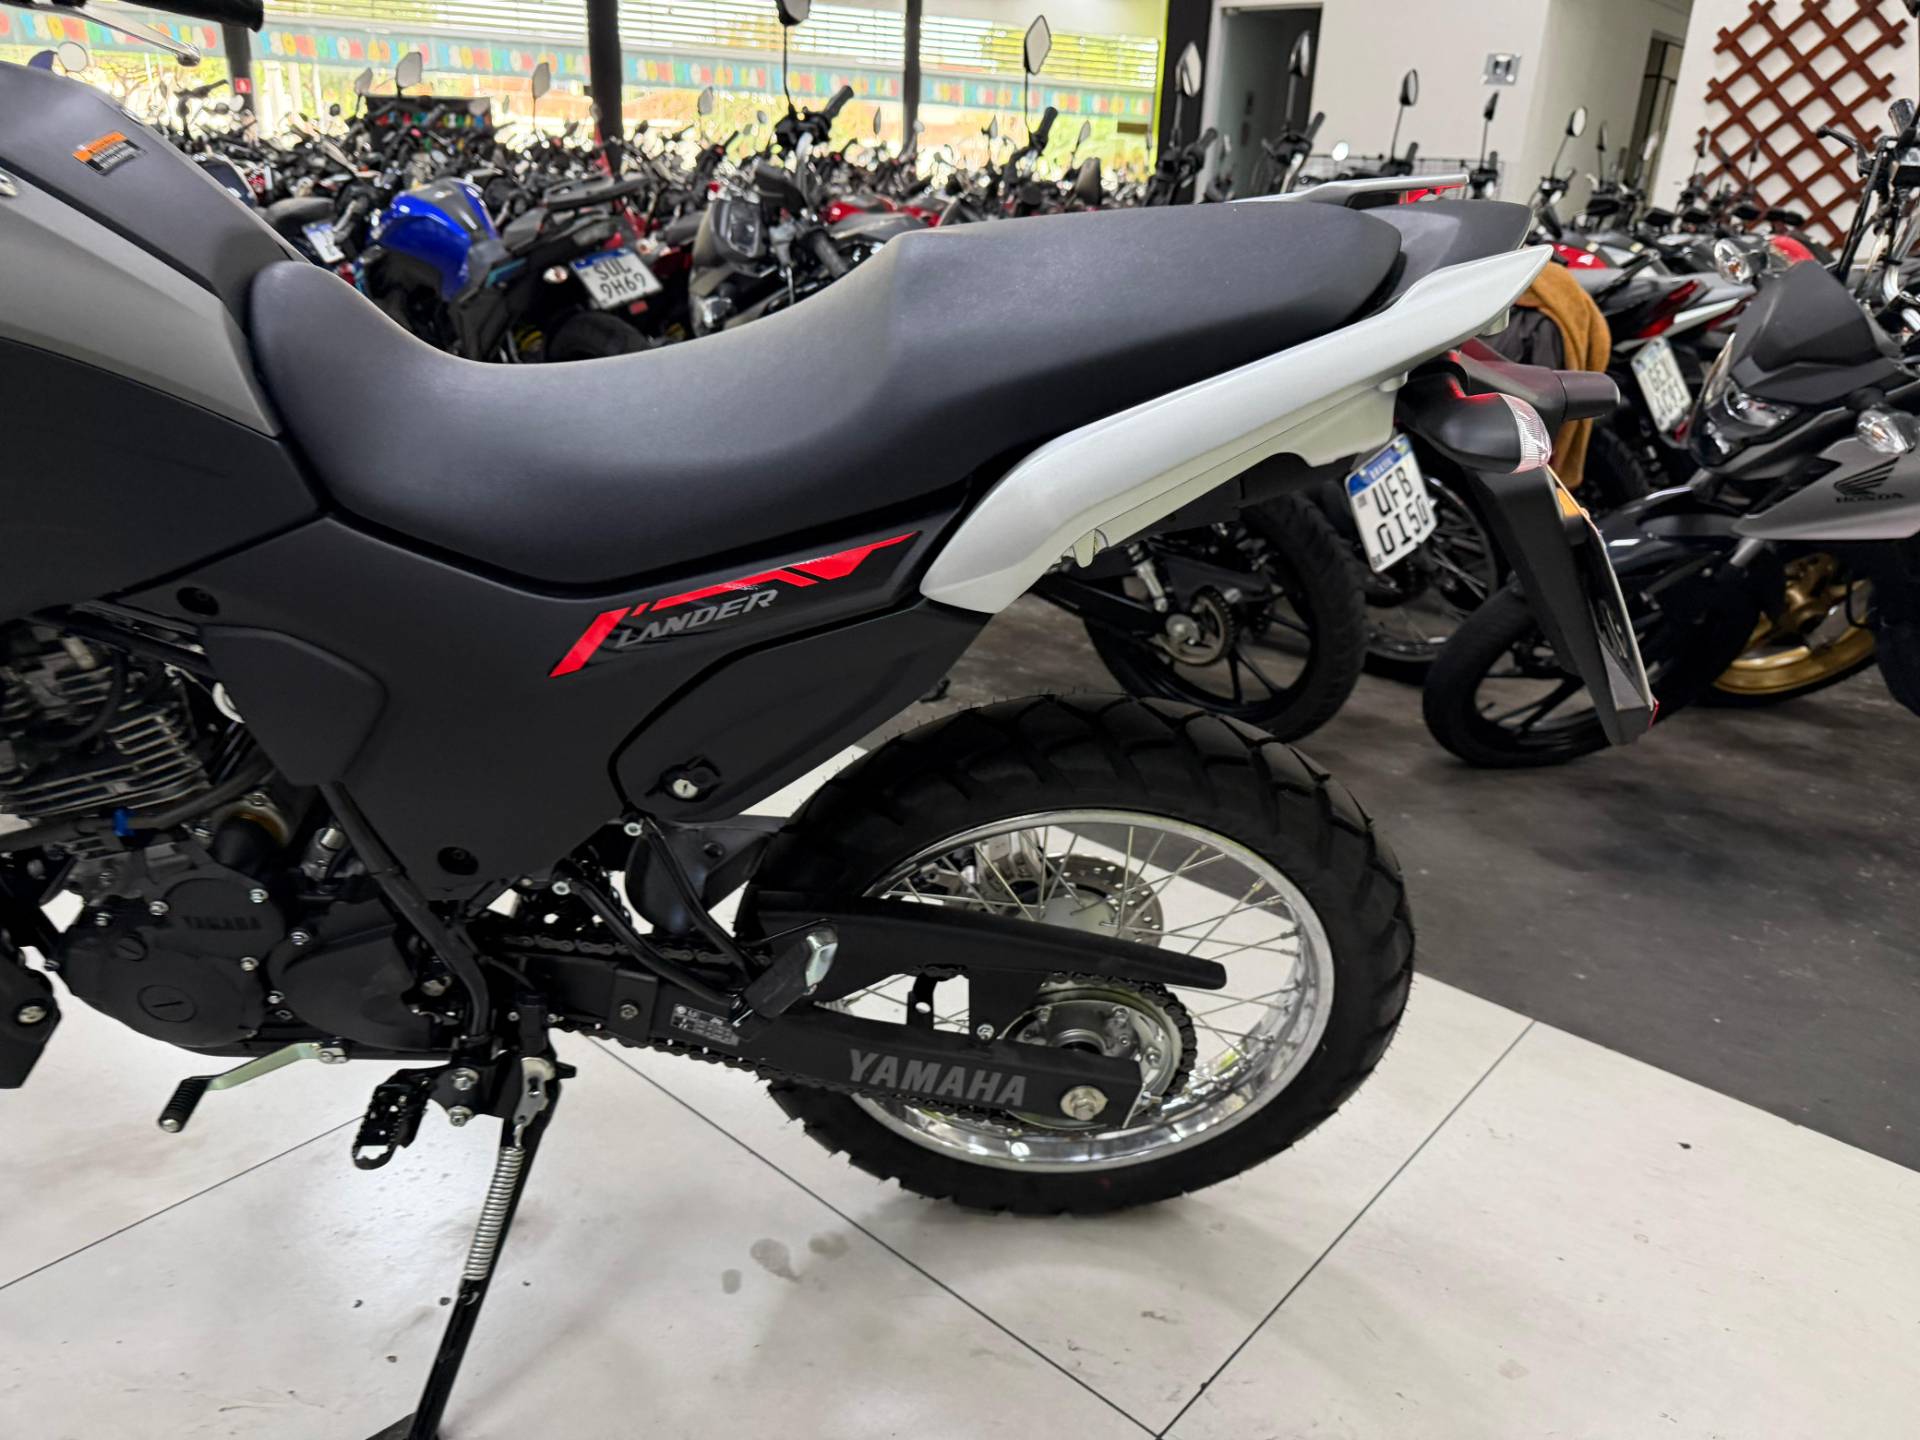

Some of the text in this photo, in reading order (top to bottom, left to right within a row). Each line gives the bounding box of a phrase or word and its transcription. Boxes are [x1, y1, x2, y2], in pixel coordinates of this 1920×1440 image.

[593, 260, 633, 281] SUL
[600, 272, 647, 299] 9H69
[1372, 466, 1412, 517] UFB
[1835, 491, 1905, 503] HONDA
[614, 589, 778, 649] LANDER
[850, 1049, 1026, 1108] YAMAHA
